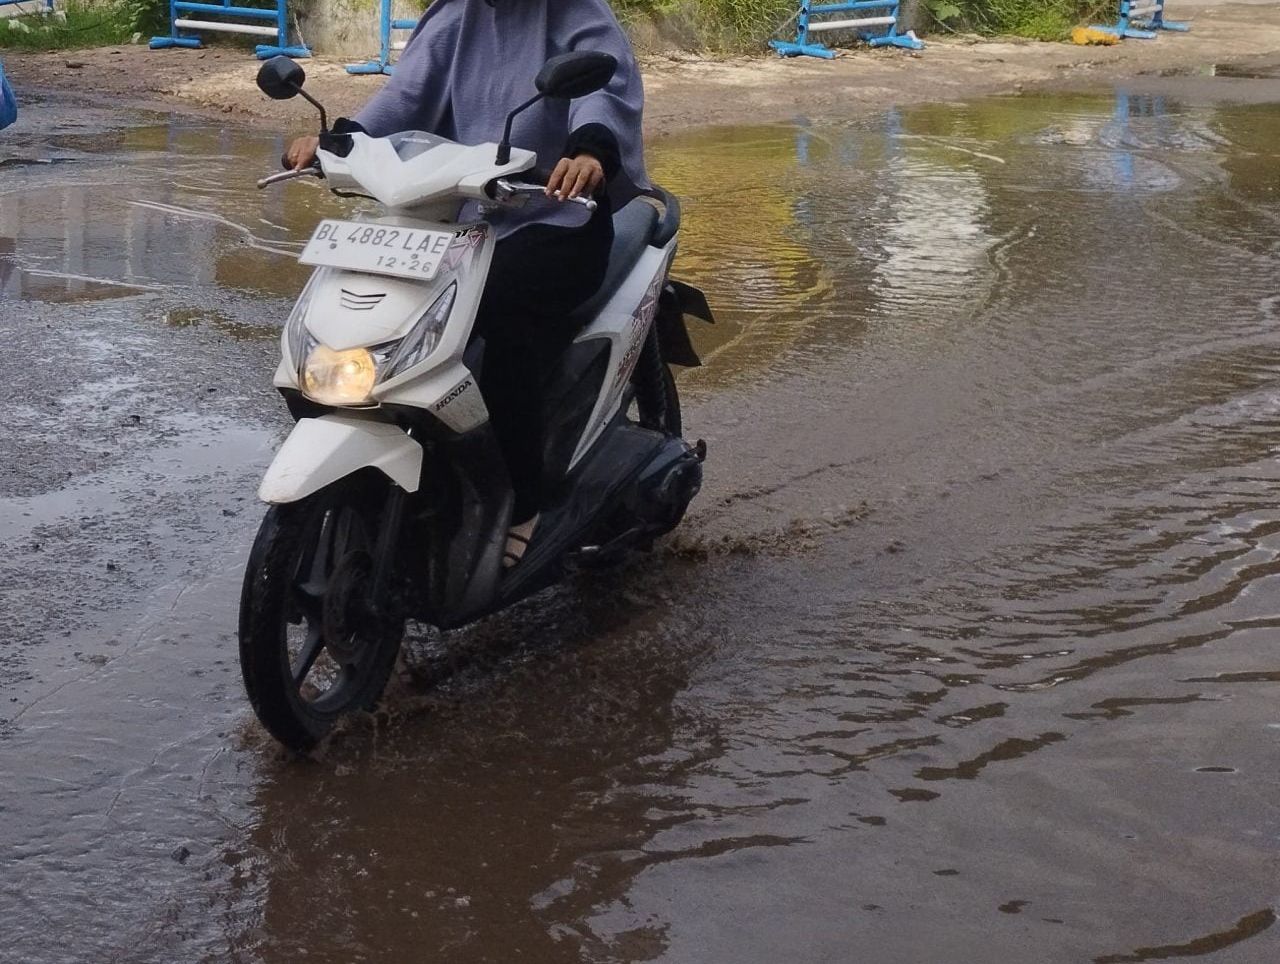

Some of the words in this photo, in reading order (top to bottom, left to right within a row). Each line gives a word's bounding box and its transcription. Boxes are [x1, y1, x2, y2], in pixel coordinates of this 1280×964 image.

[316, 223, 339, 243] BL
[347, 226, 400, 248] 4882
[402, 232, 449, 254] LAE
[436, 380, 472, 411] HONDA
